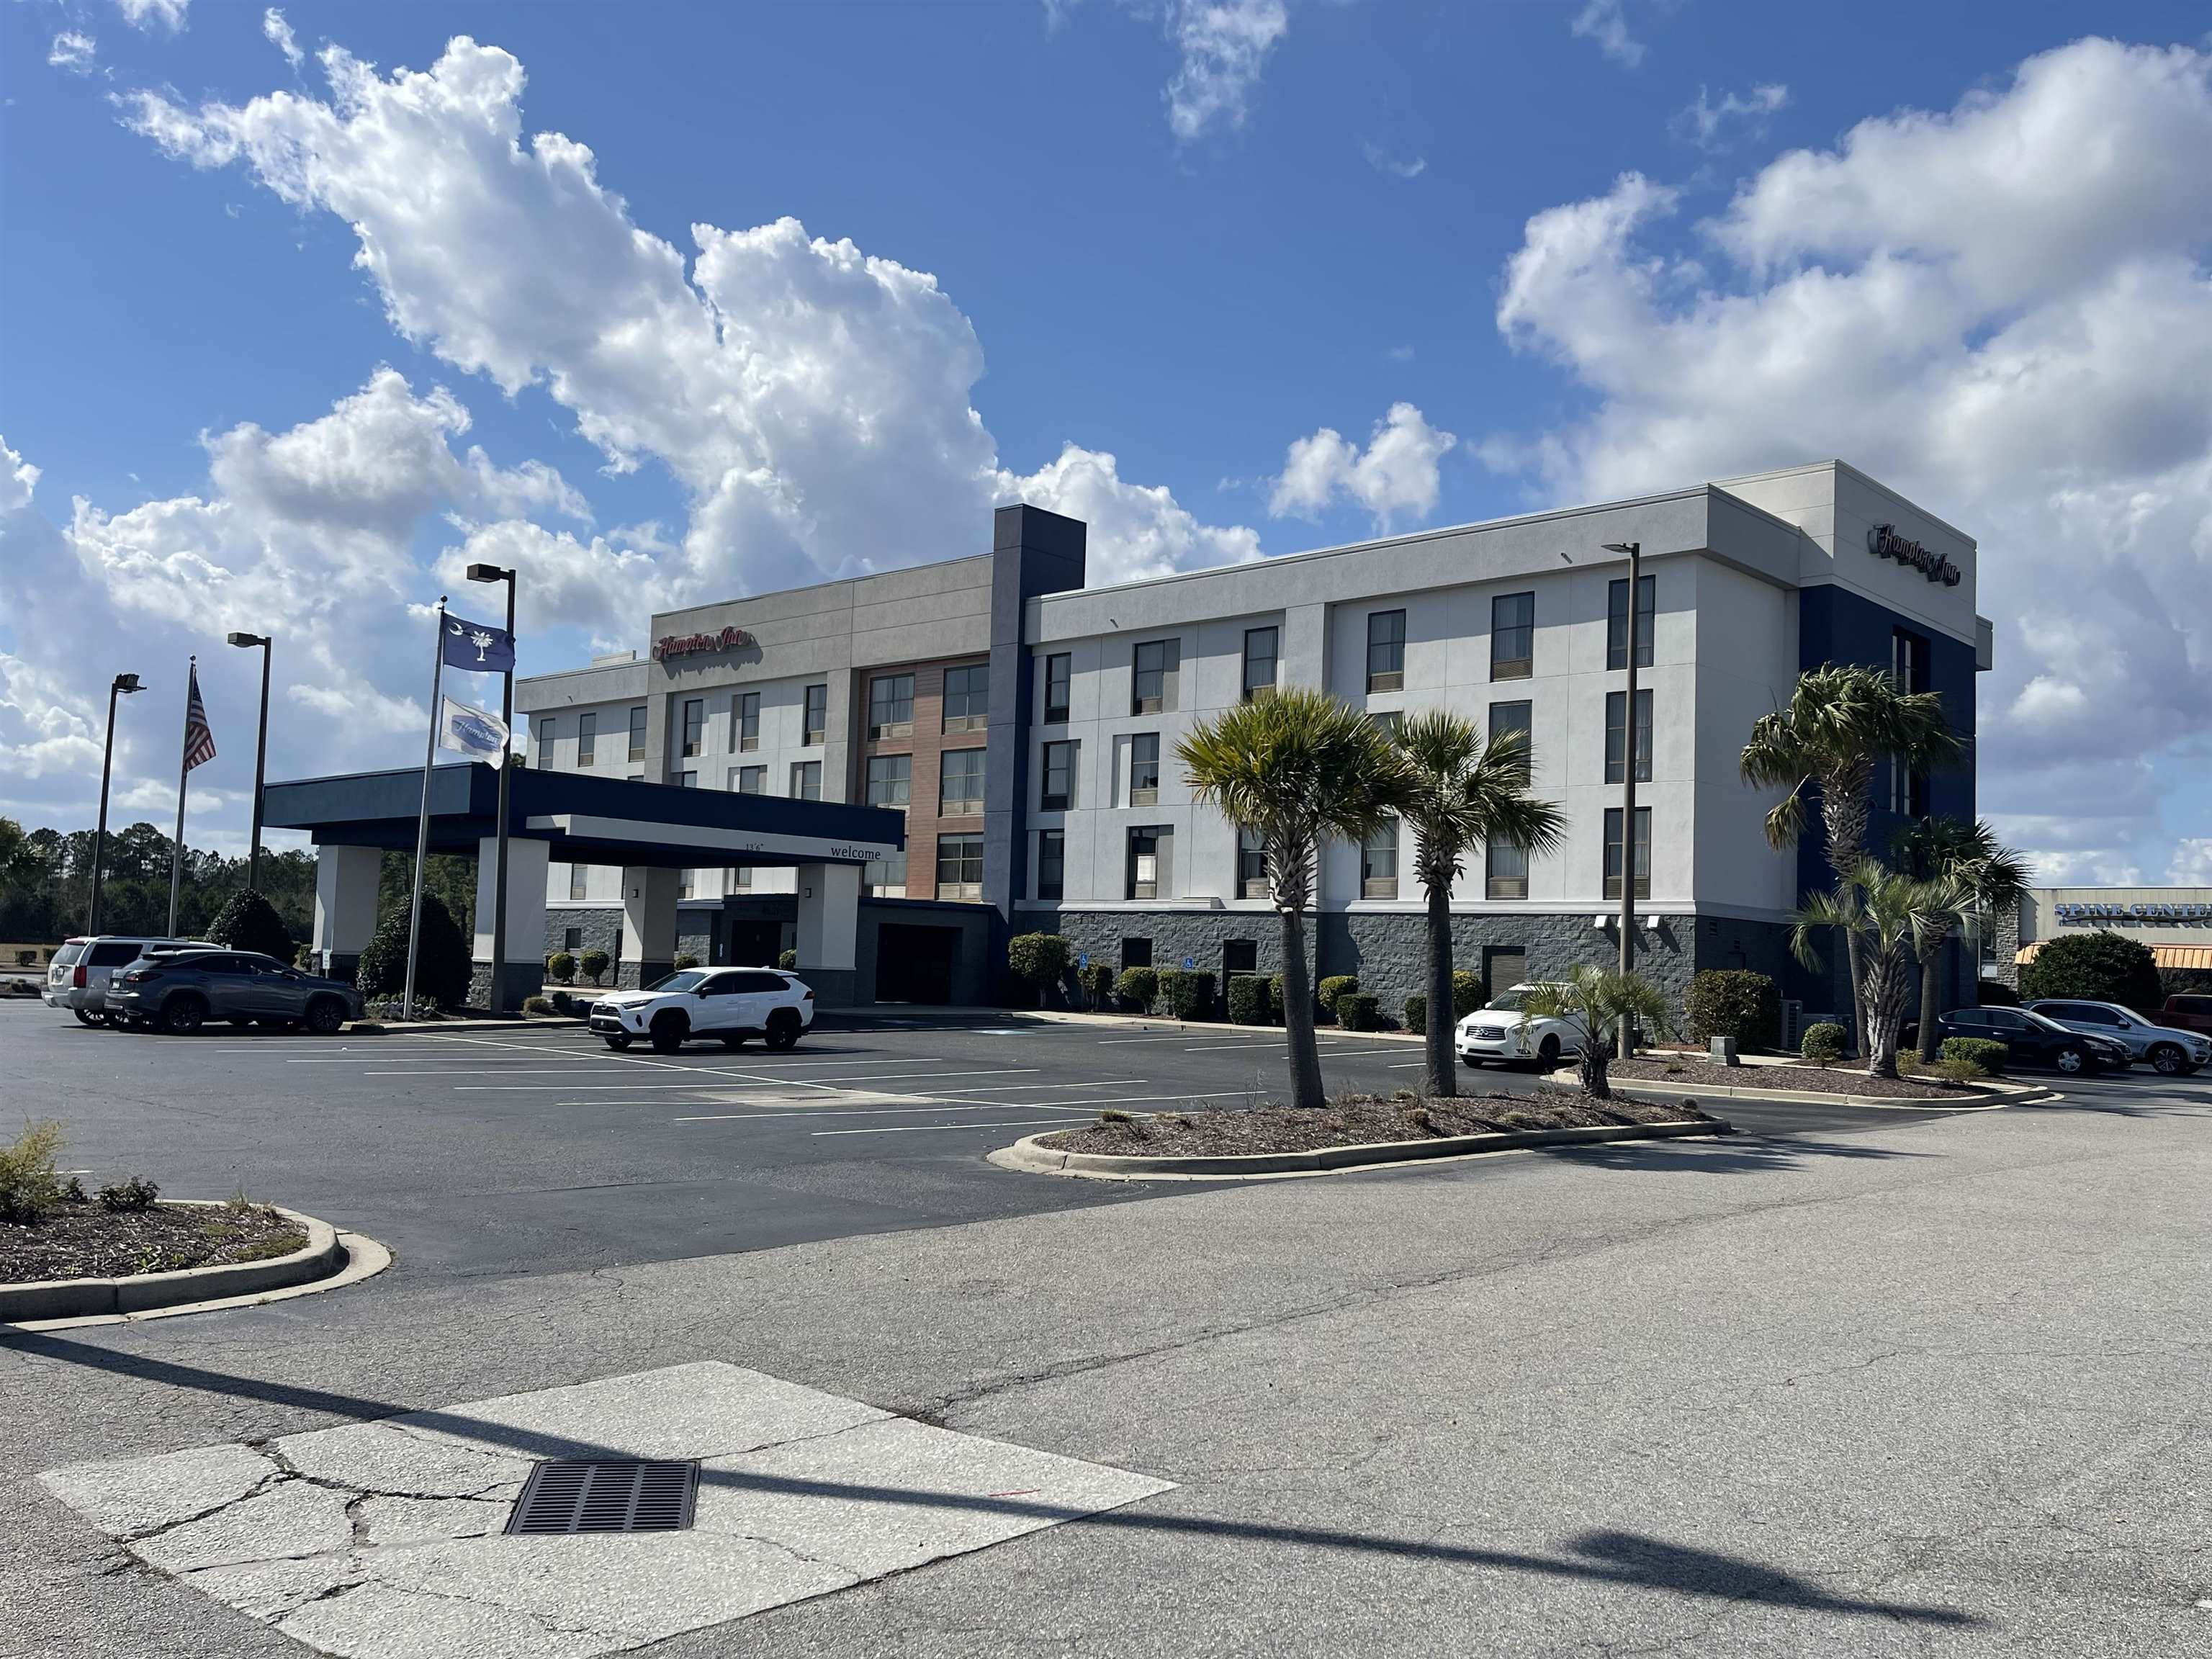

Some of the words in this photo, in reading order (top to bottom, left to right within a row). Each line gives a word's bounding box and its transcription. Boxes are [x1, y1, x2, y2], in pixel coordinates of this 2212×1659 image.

[1869, 523, 1934, 572] Hampton
[1936, 553, 1961, 585] Inn
[653, 635, 714, 661] Hampton
[716, 626, 747, 651] Inn
[831, 845, 881, 860] welcome
[2054, 903, 2123, 917] SPINE
[2131, 903, 2212, 917] CENTE
